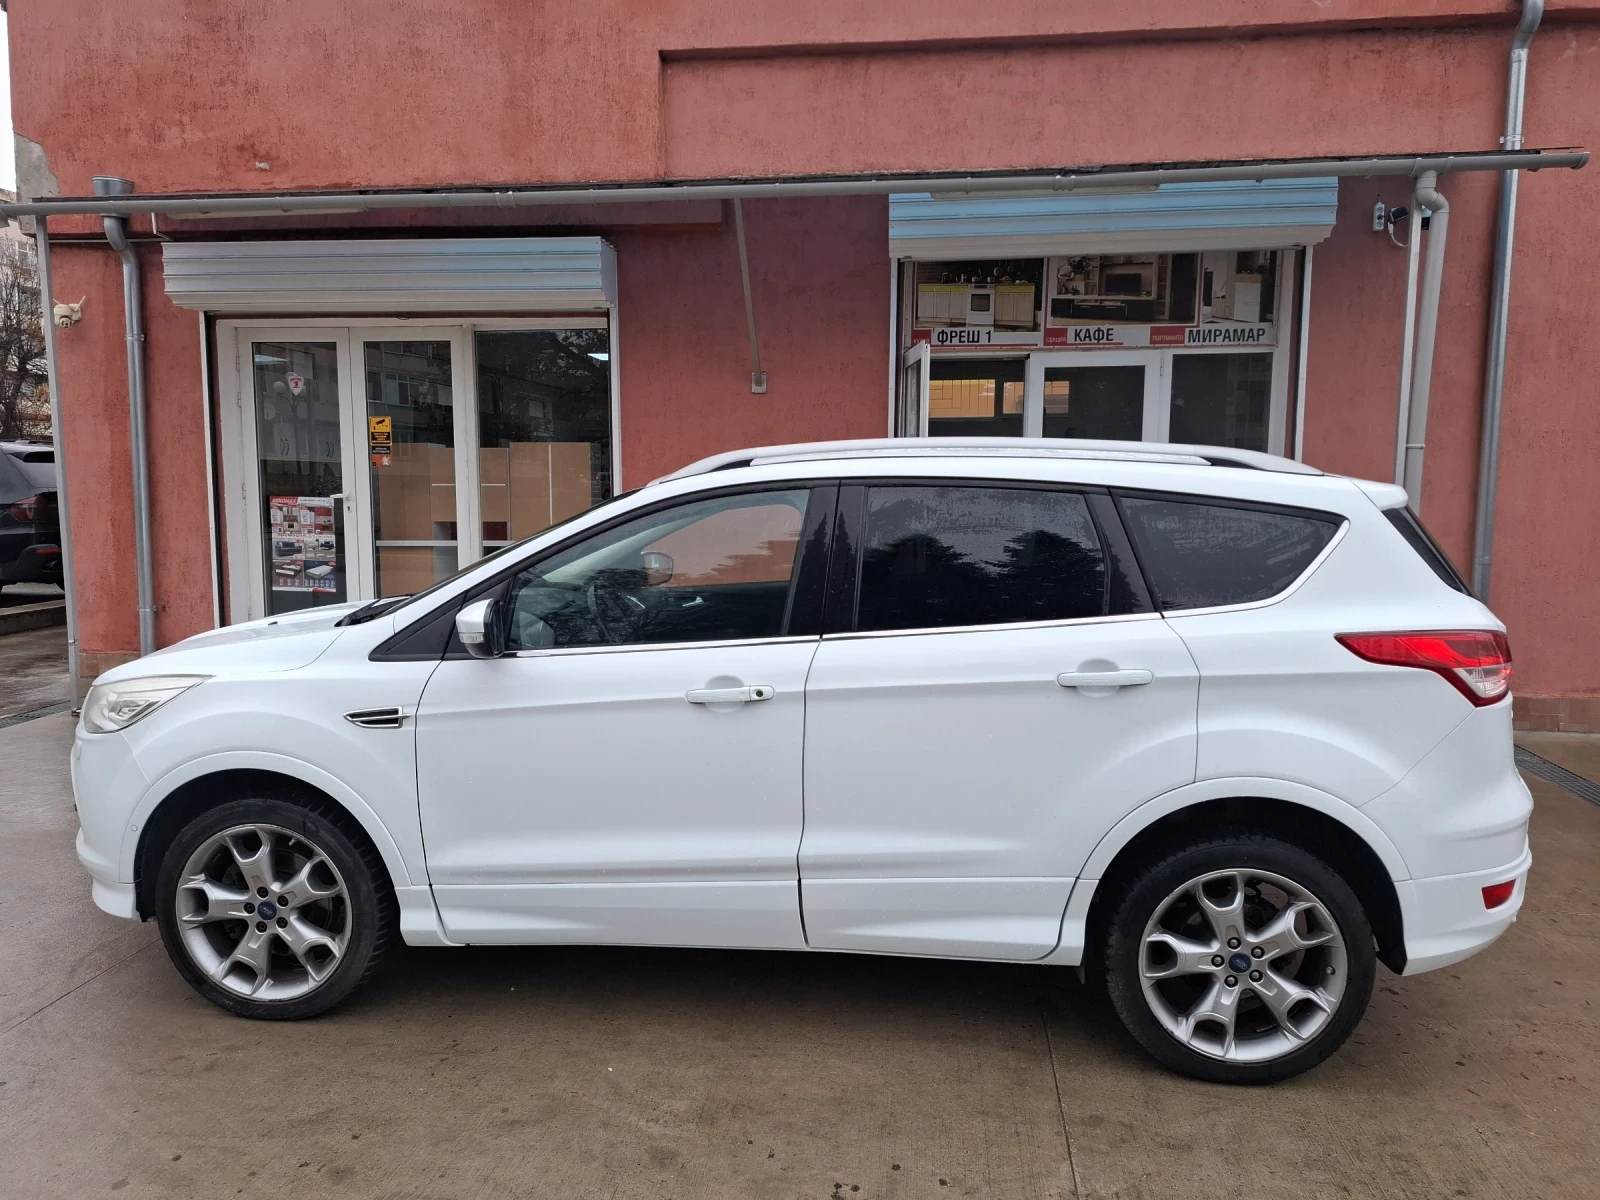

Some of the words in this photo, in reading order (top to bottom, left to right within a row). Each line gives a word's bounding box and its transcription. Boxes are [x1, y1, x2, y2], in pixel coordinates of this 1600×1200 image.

[937, 329, 980, 345] ФРЕШ
[985, 330, 992, 343] 1
[1074, 327, 1114, 343] КАФЕ
[1187, 328, 1266, 343] МИРАМАР
